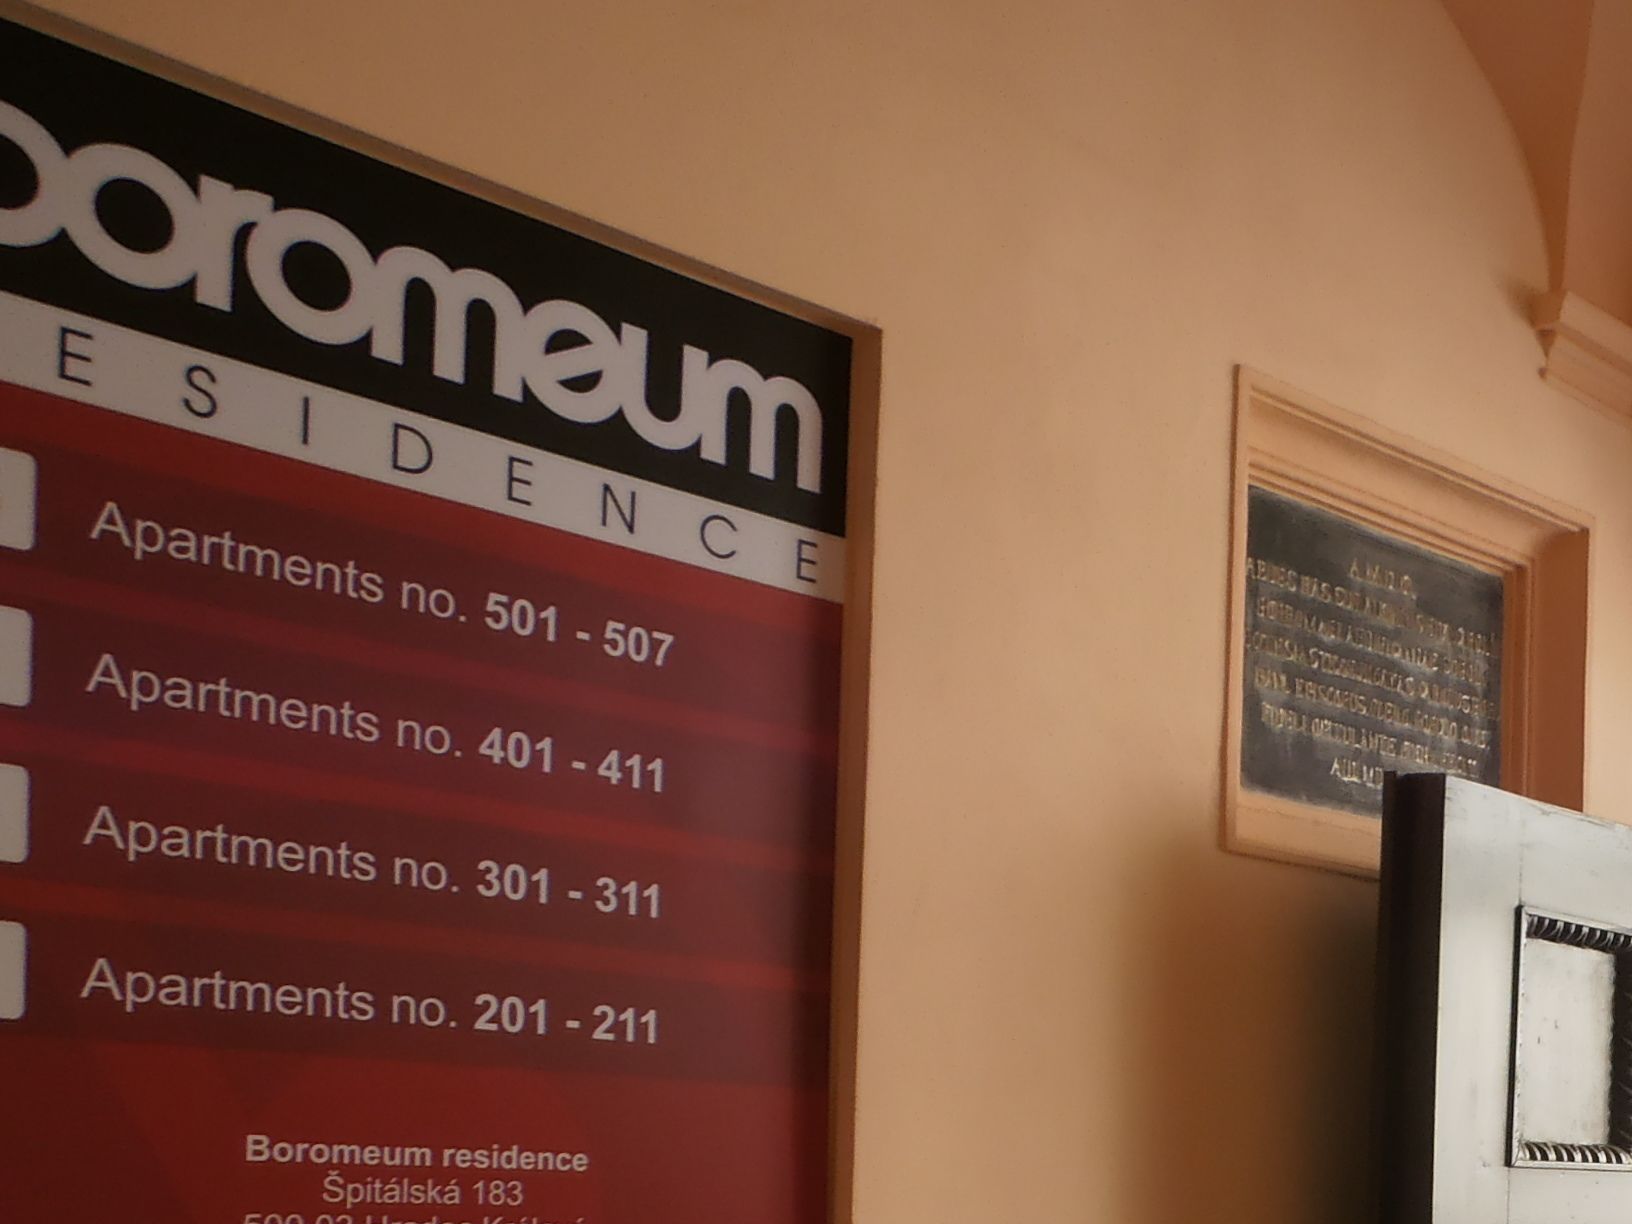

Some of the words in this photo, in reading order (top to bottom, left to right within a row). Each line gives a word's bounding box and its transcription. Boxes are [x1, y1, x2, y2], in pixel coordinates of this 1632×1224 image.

[90, 501, 386, 603] Apartments
[400, 578, 468, 622] no.
[485, 591, 558, 642] 501
[603, 620, 674, 667] 507
[85, 652, 381, 743] Apartments
[396, 718, 463, 758] no.
[478, 726, 553, 773] 401
[598, 748, 665, 793] 411
[83, 805, 377, 881] Apartments
[393, 855, 460, 893] no.
[475, 859, 550, 904] 301
[594, 876, 661, 918] 311
[81, 957, 374, 1021] Apartments
[391, 993, 457, 1029] no.
[473, 992, 547, 1035] 201
[591, 1004, 658, 1044] 211
[245, 1134, 432, 1167] Boromeum
[442, 1144, 590, 1173] residence
[322, 1170, 460, 1208] Špitálská
[473, 1181, 524, 1207] 183
